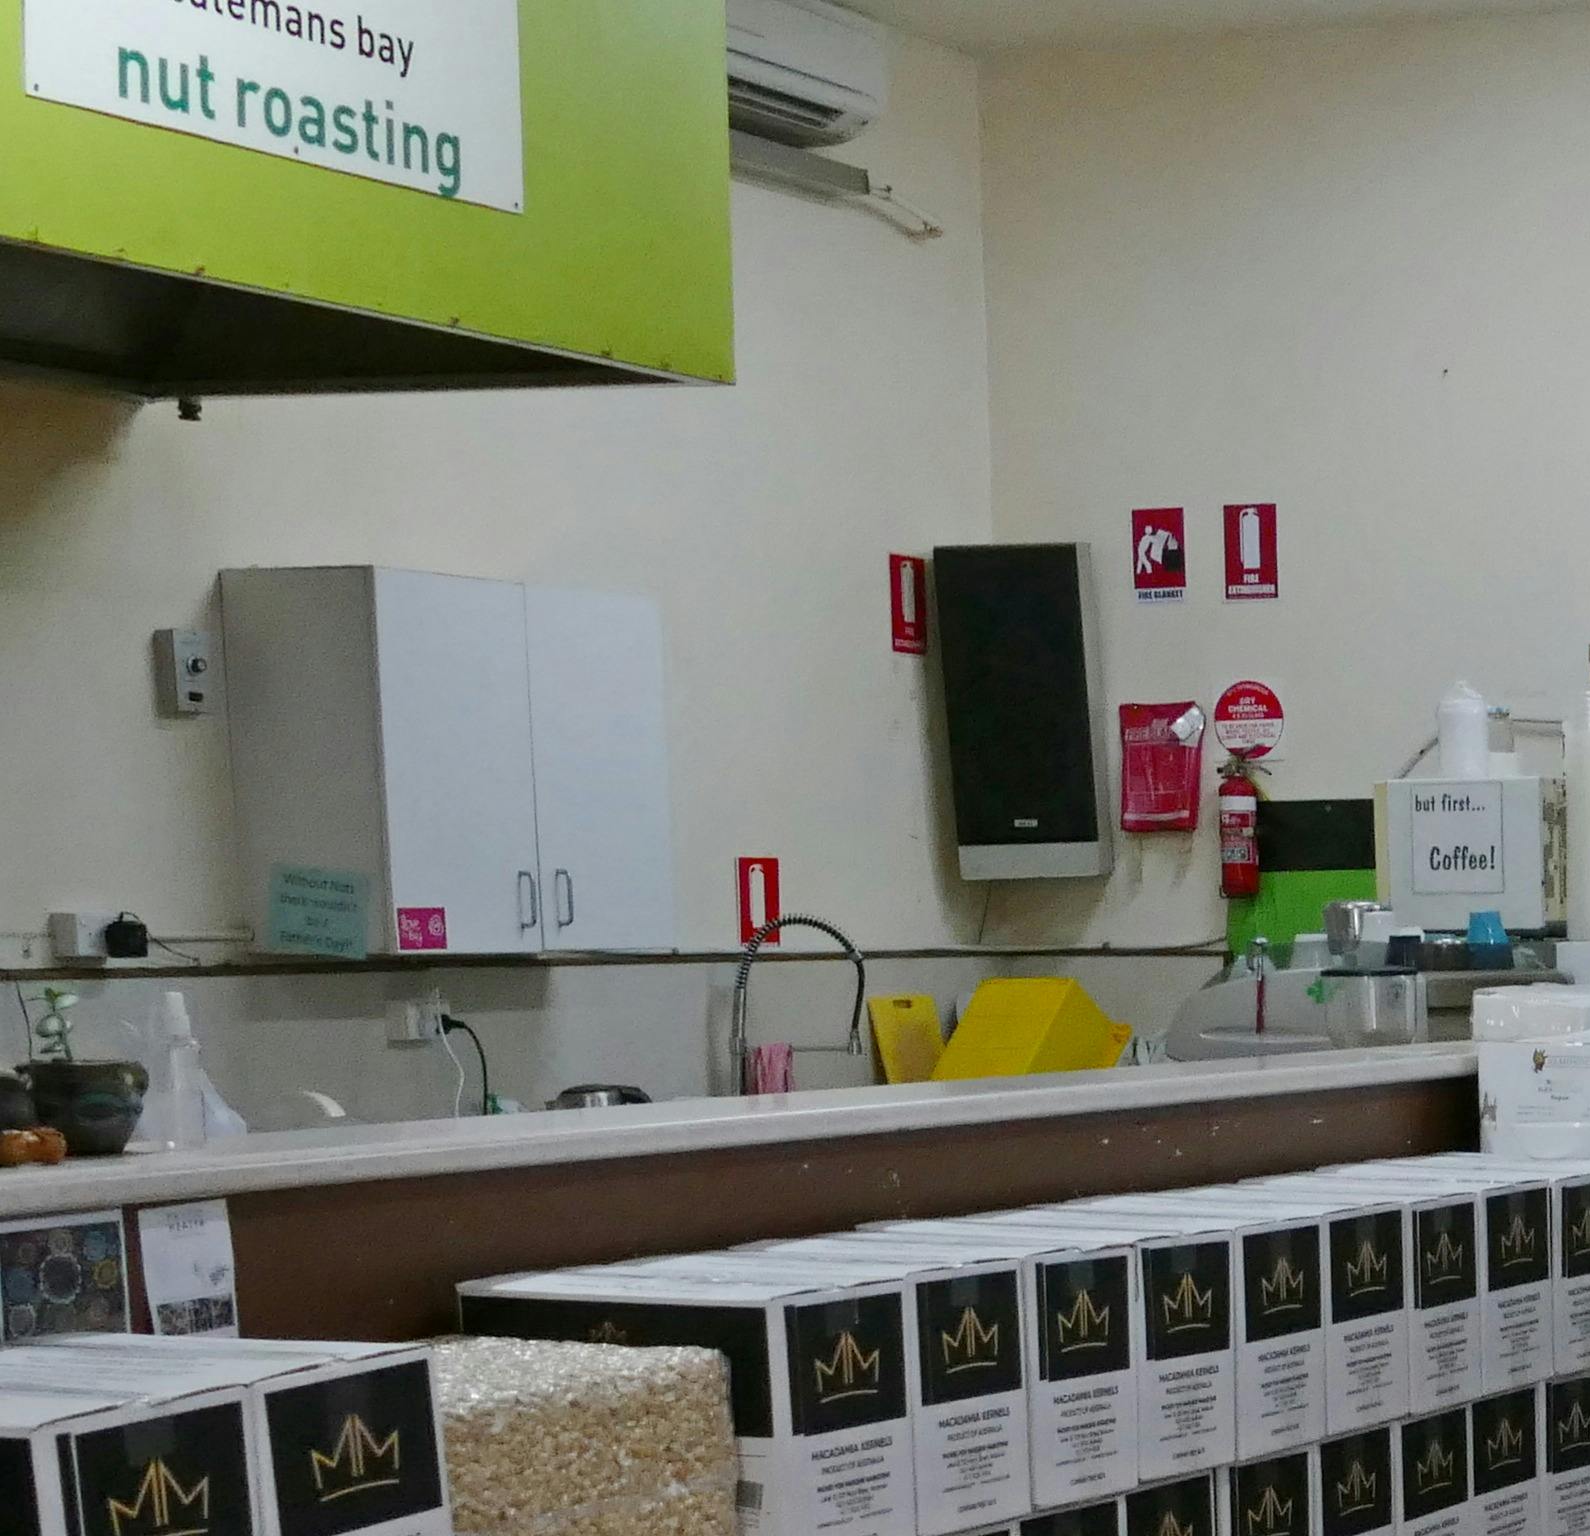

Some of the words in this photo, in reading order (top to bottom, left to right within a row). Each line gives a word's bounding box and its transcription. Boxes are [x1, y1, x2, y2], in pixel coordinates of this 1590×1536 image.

[172, 0, 345, 49] emans
[358, 15, 413, 77] bay
[118, 46, 215, 120] nut
[236, 77, 460, 199] roasting
[1243, 573, 1260, 583] FIRE
[1138, 590, 1152, 600] FIRE
[1414, 794, 1435, 812] but
[1440, 794, 1486, 812] first...
[1429, 845, 1496, 871] Coffee!
